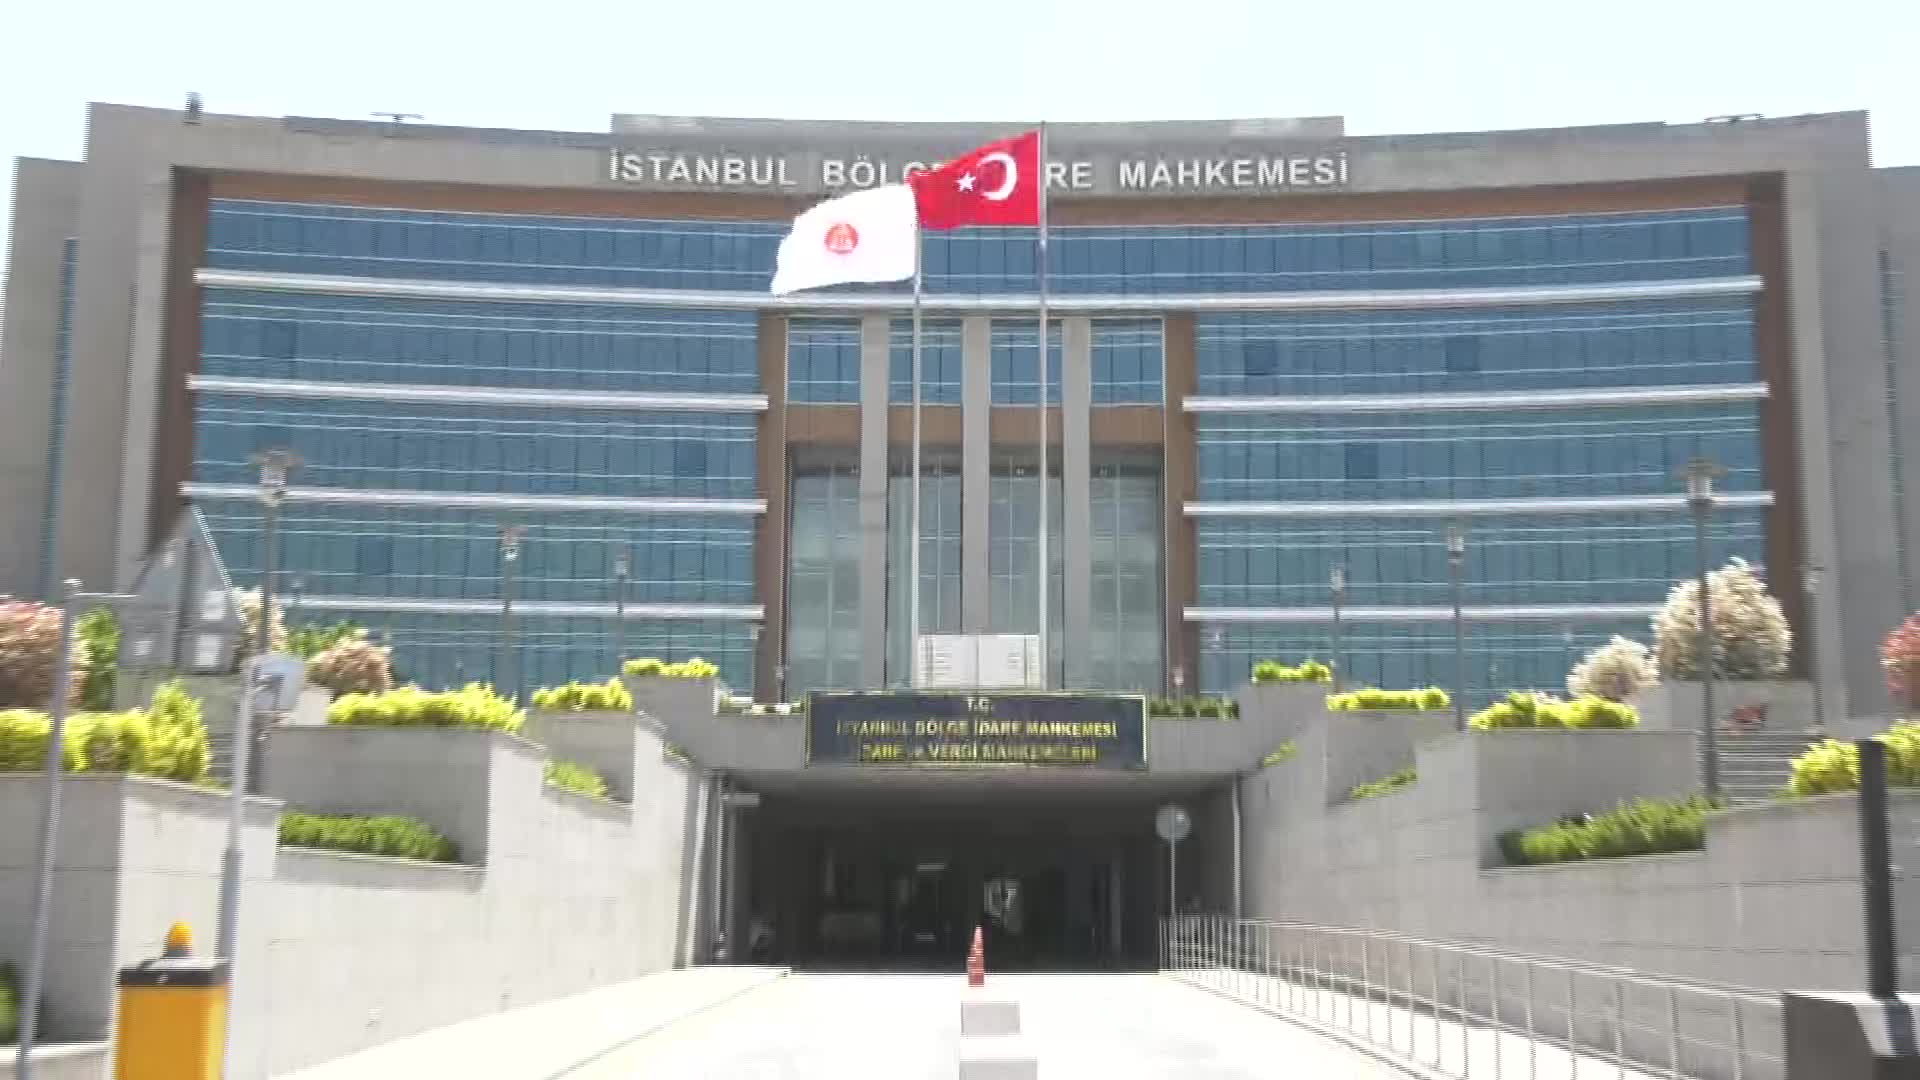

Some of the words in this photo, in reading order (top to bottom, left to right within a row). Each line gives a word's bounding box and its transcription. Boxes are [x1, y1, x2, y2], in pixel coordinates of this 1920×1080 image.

[609, 147, 798, 186] İSTANBUL
[822, 152, 946, 188] BÖL
[1119, 151, 1349, 189] MAHKEMESİ
